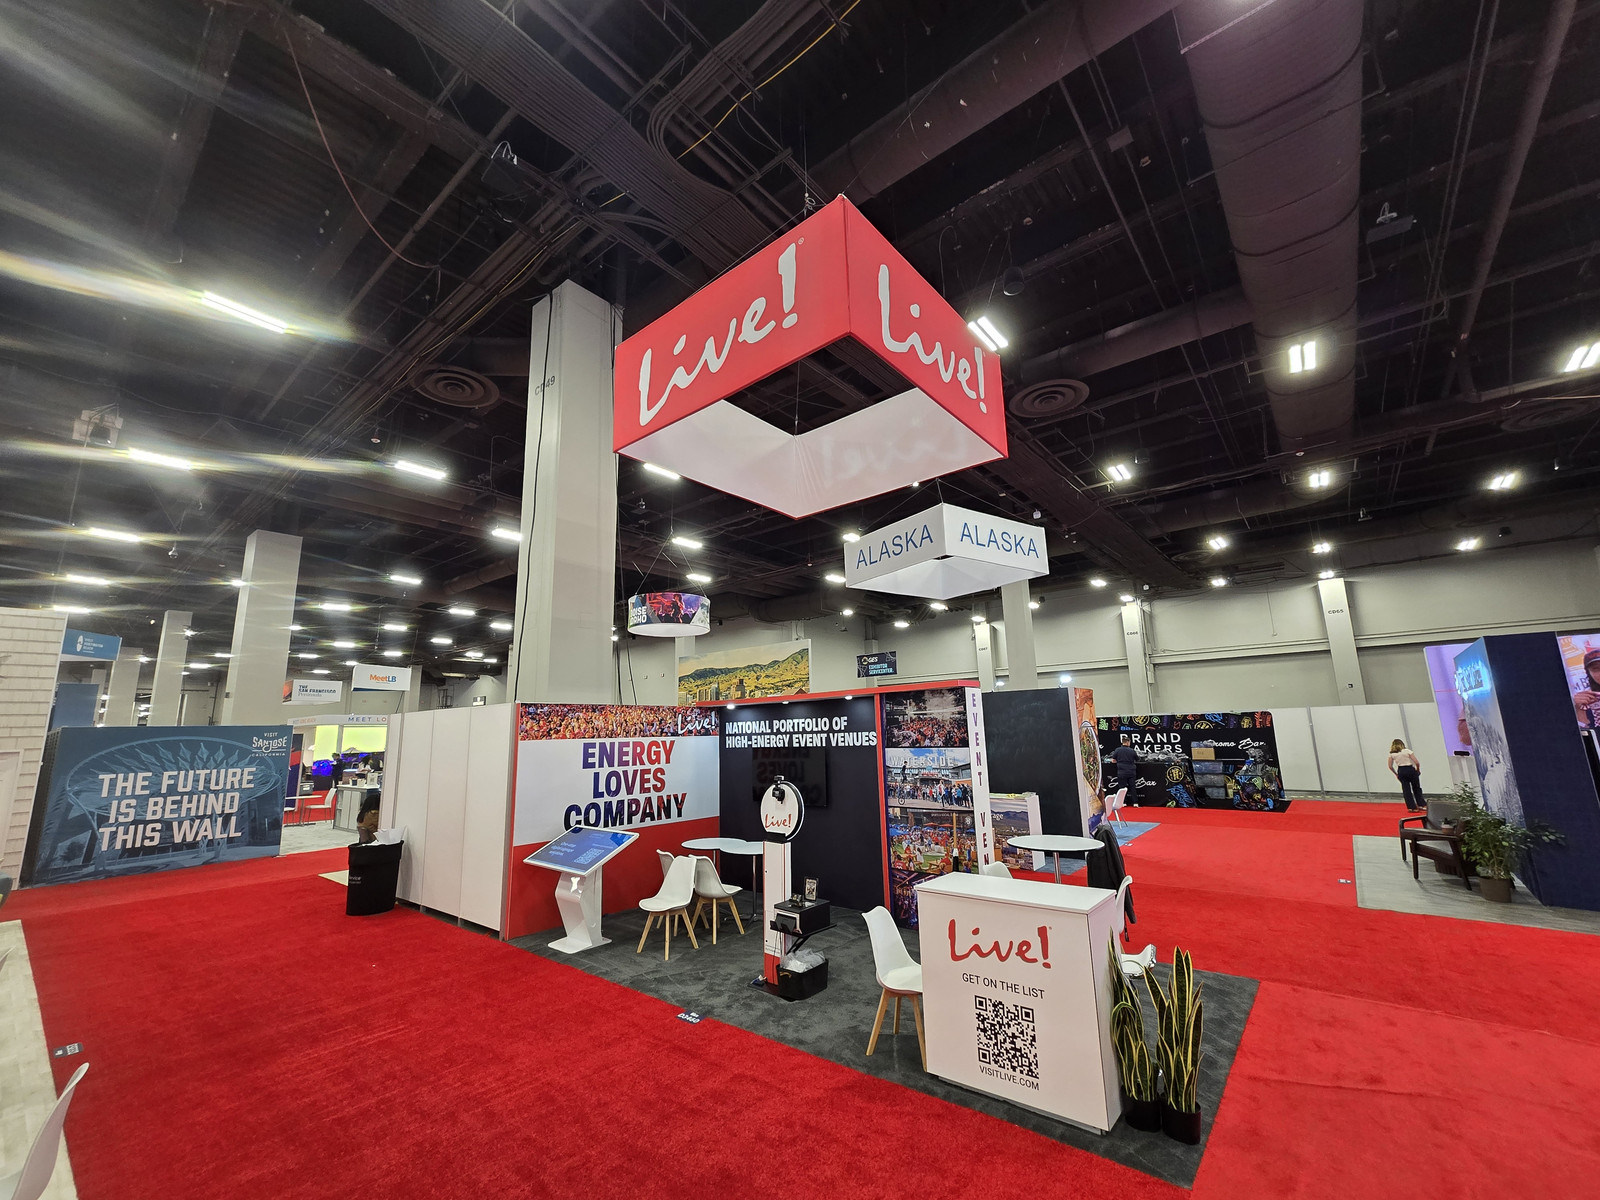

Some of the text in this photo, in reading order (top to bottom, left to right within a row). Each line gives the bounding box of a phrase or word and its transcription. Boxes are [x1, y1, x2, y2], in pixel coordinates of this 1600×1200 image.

[638, 242, 798, 427] Live!
[877, 263, 988, 414] Live!
[856, 524, 933, 570] ALASKA
[959, 522, 1040, 559] ALASKA
[369, 673, 397, 683] MeetLB
[677, 710, 716, 735] Live!
[725, 716, 848, 735] NATIONAL PORTFOLIO OF
[581, 740, 676, 770] ENERGY
[725, 731, 878, 749] HIGH-ENERGY EVENT VENUES
[971, 693, 983, 787] EVENT
[98, 767, 257, 798] THE FUTURE
[592, 767, 667, 799] LOVES
[108, 792, 241, 824] IS BEHIND
[563, 793, 688, 830] COMPANY
[765, 813, 792, 829] Live!
[98, 816, 242, 852] THIS WALL
[948, 918, 1052, 969] Live!
[962, 972, 1045, 1000] GET ON THE LIST
[979, 1064, 1040, 1091] VISITLIVE.COM
